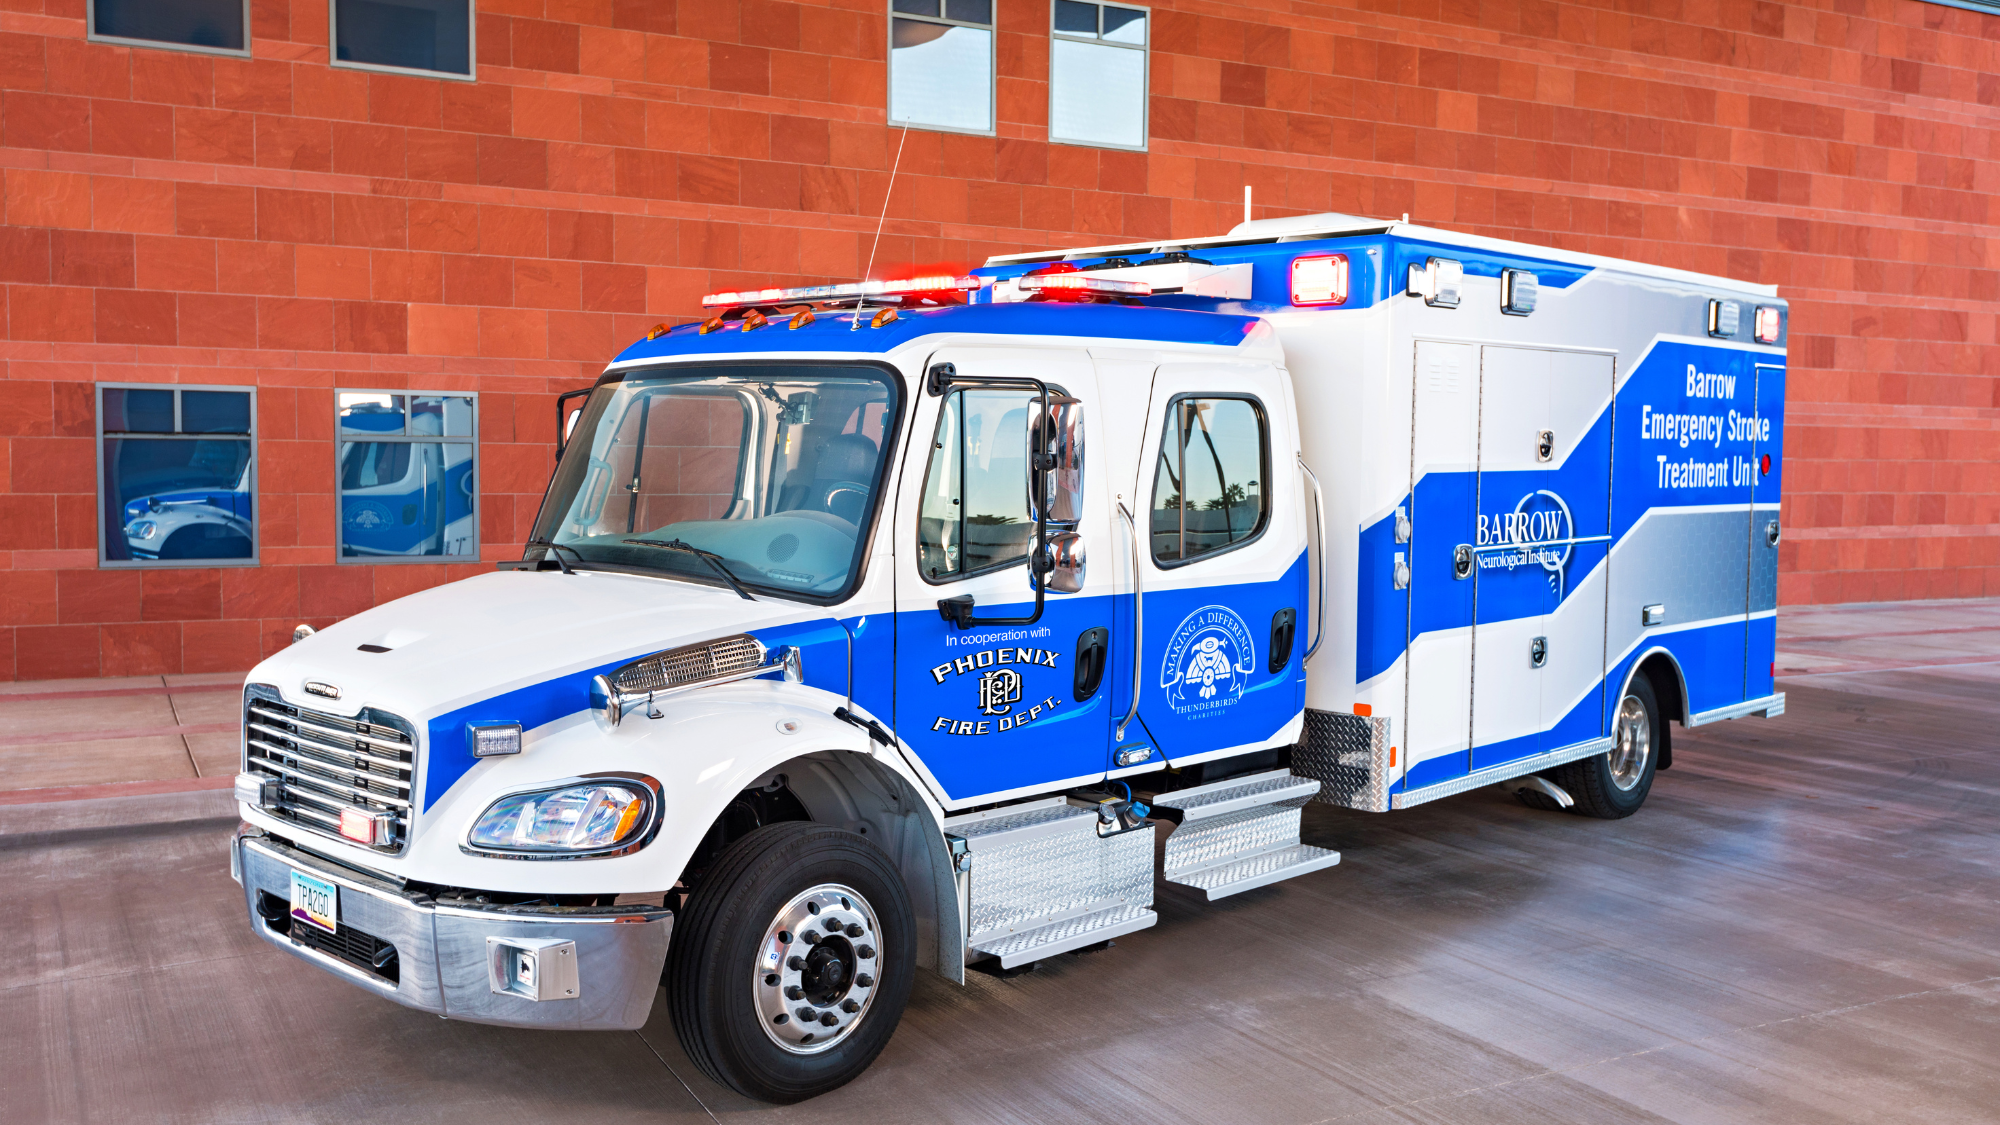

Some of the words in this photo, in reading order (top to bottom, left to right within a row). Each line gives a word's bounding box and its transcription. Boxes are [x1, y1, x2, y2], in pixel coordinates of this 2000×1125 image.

[1686, 363, 1736, 399] Barrow
[1641, 404, 1723, 448] Emergency
[1727, 408, 1770, 442] Stroke
[1656, 455, 1729, 489] Treatment
[1732, 455, 1760, 487] Unt
[1477, 510, 1562, 545] BARROW
[1477, 549, 1527, 571] Neurological
[1528, 546, 1560, 565] Institute
[946, 634, 957, 647] In
[960, 629, 1028, 646] cooperation
[1030, 626, 1051, 639] with
[1166, 620, 1196, 676] MAKING
[1198, 615, 1205, 627] A
[1207, 612, 1251, 666] DIFFERENCE
[930, 647, 1061, 684] PHOENIX
[930, 716, 991, 735] FIRE
[998, 696, 1062, 732] DEPT.
[1175, 697, 1238, 715] THUNDERBIRDS
[1187, 709, 1226, 721] CHARITIES
